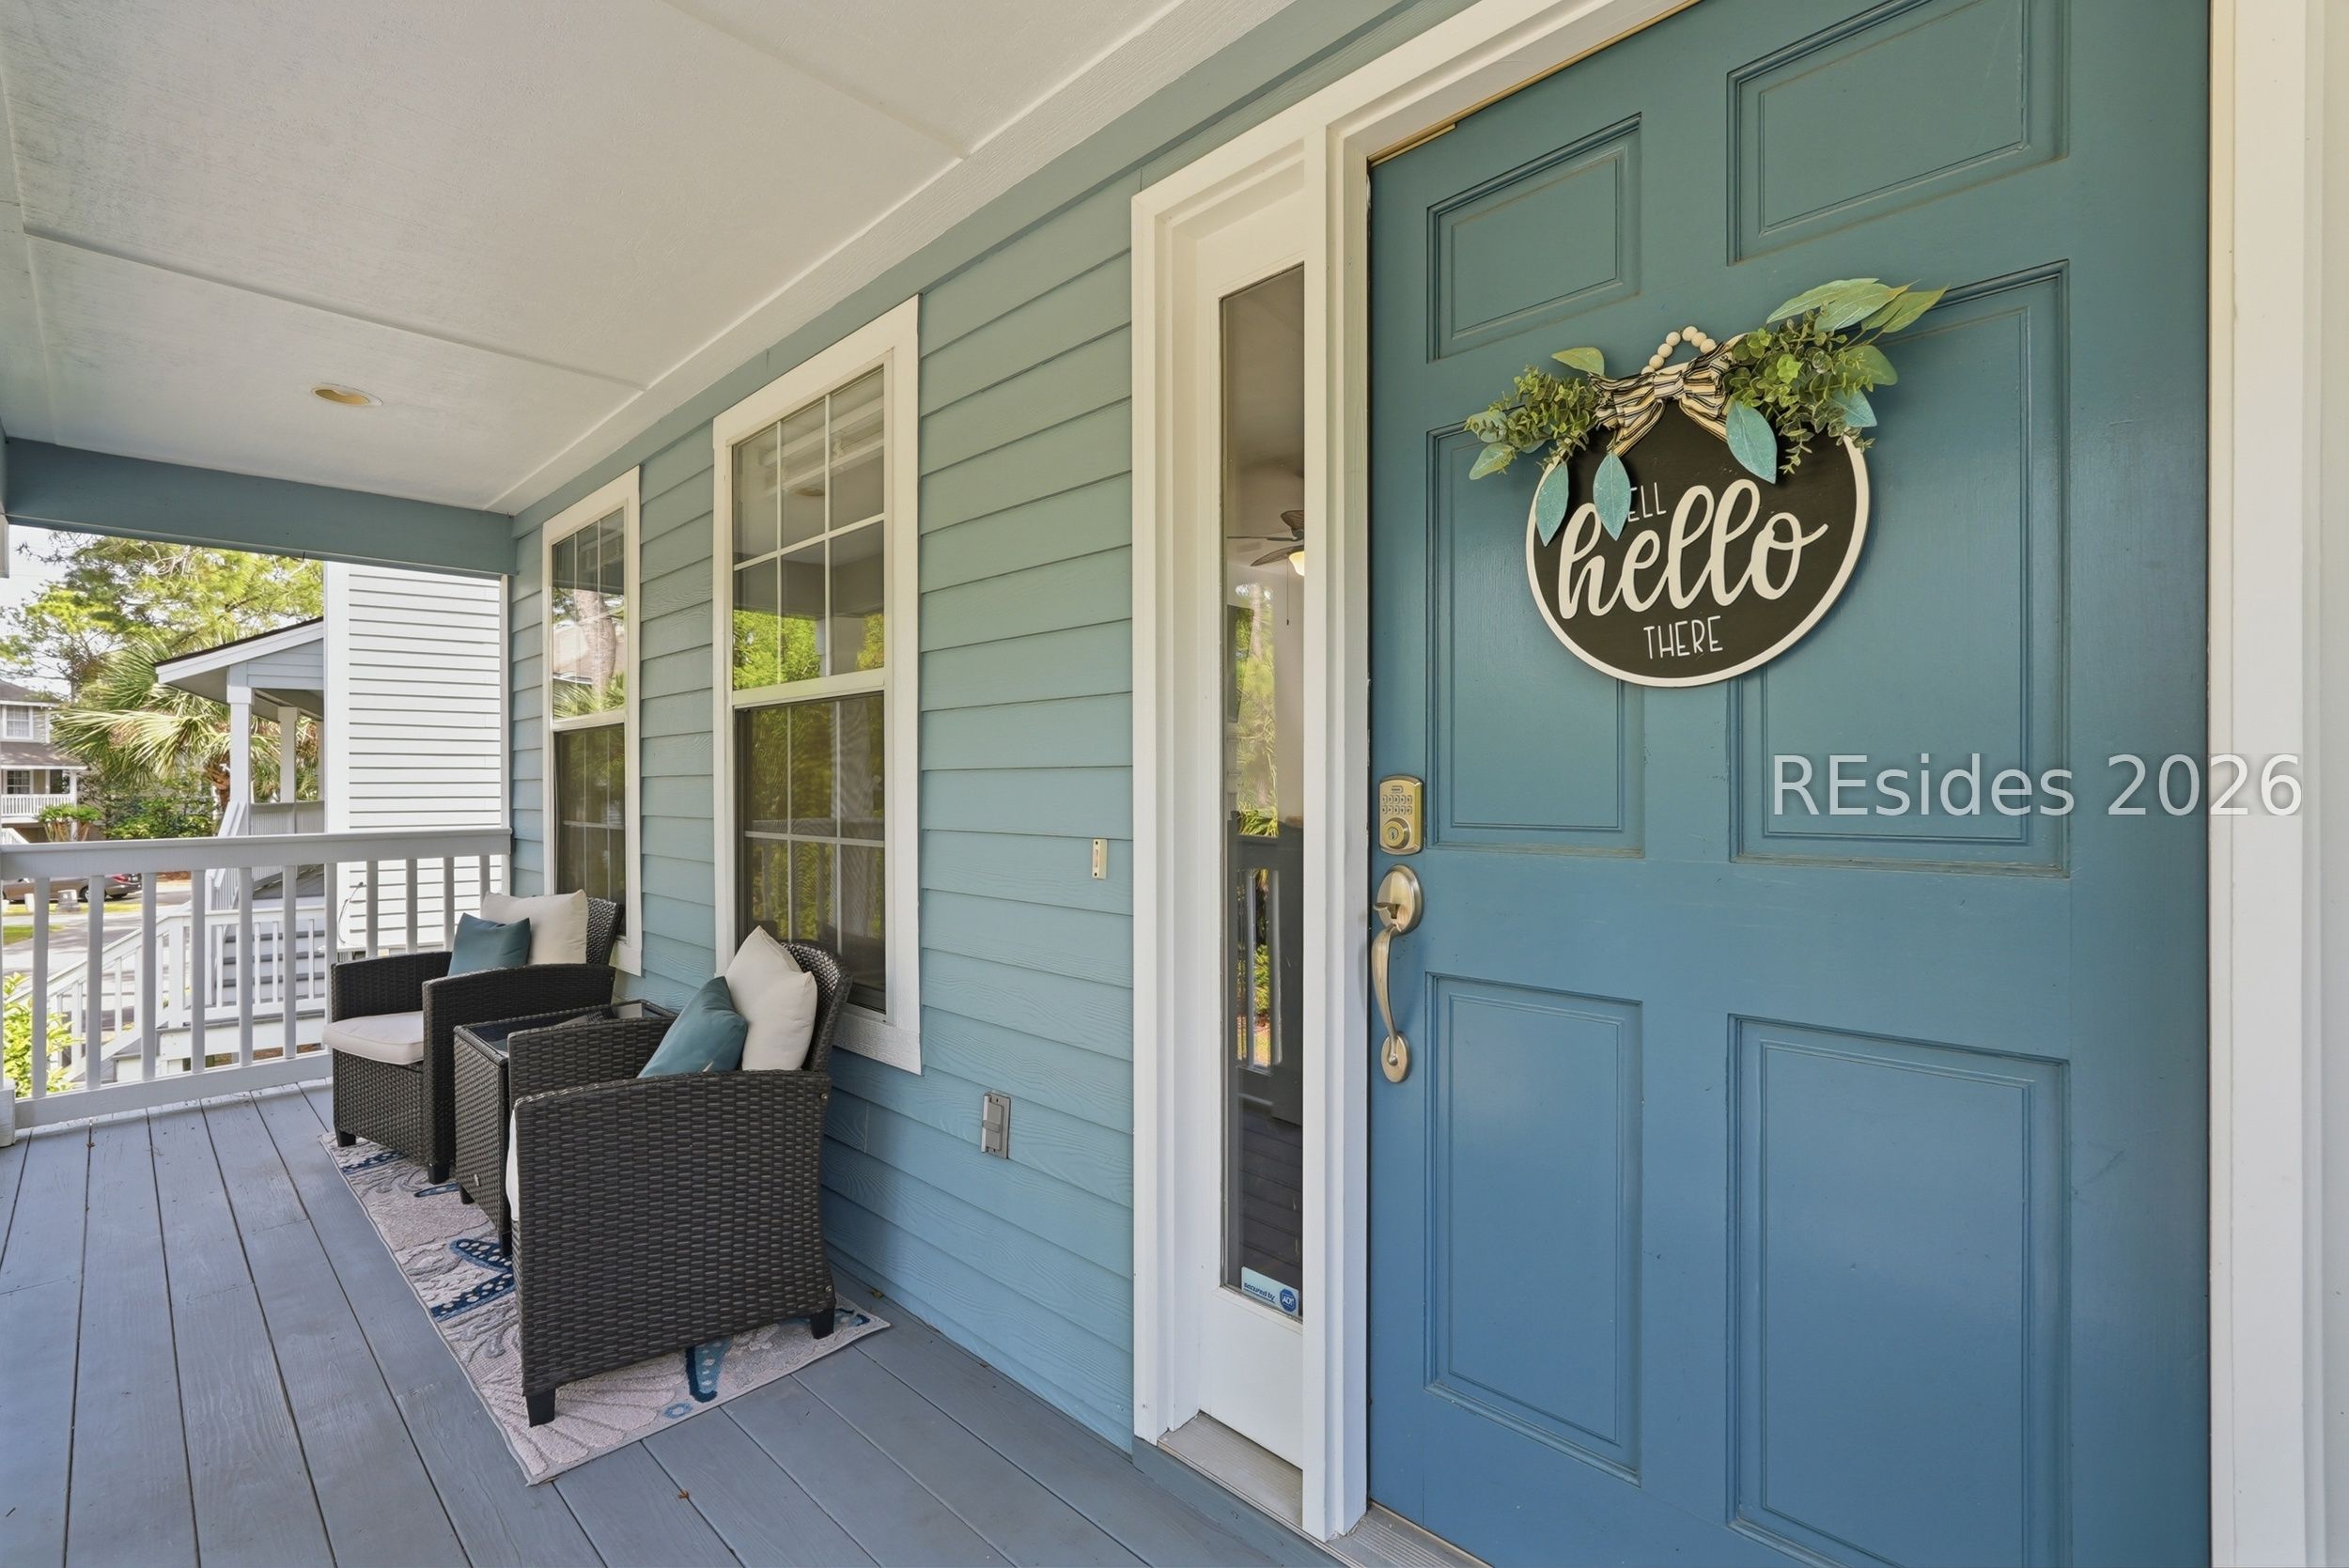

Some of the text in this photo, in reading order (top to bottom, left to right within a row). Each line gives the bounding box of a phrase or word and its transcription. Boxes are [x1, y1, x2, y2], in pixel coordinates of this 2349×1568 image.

[1628, 482, 1667, 522] ELL
[1558, 478, 1829, 620] hello
[1643, 615, 1724, 660] THERE
